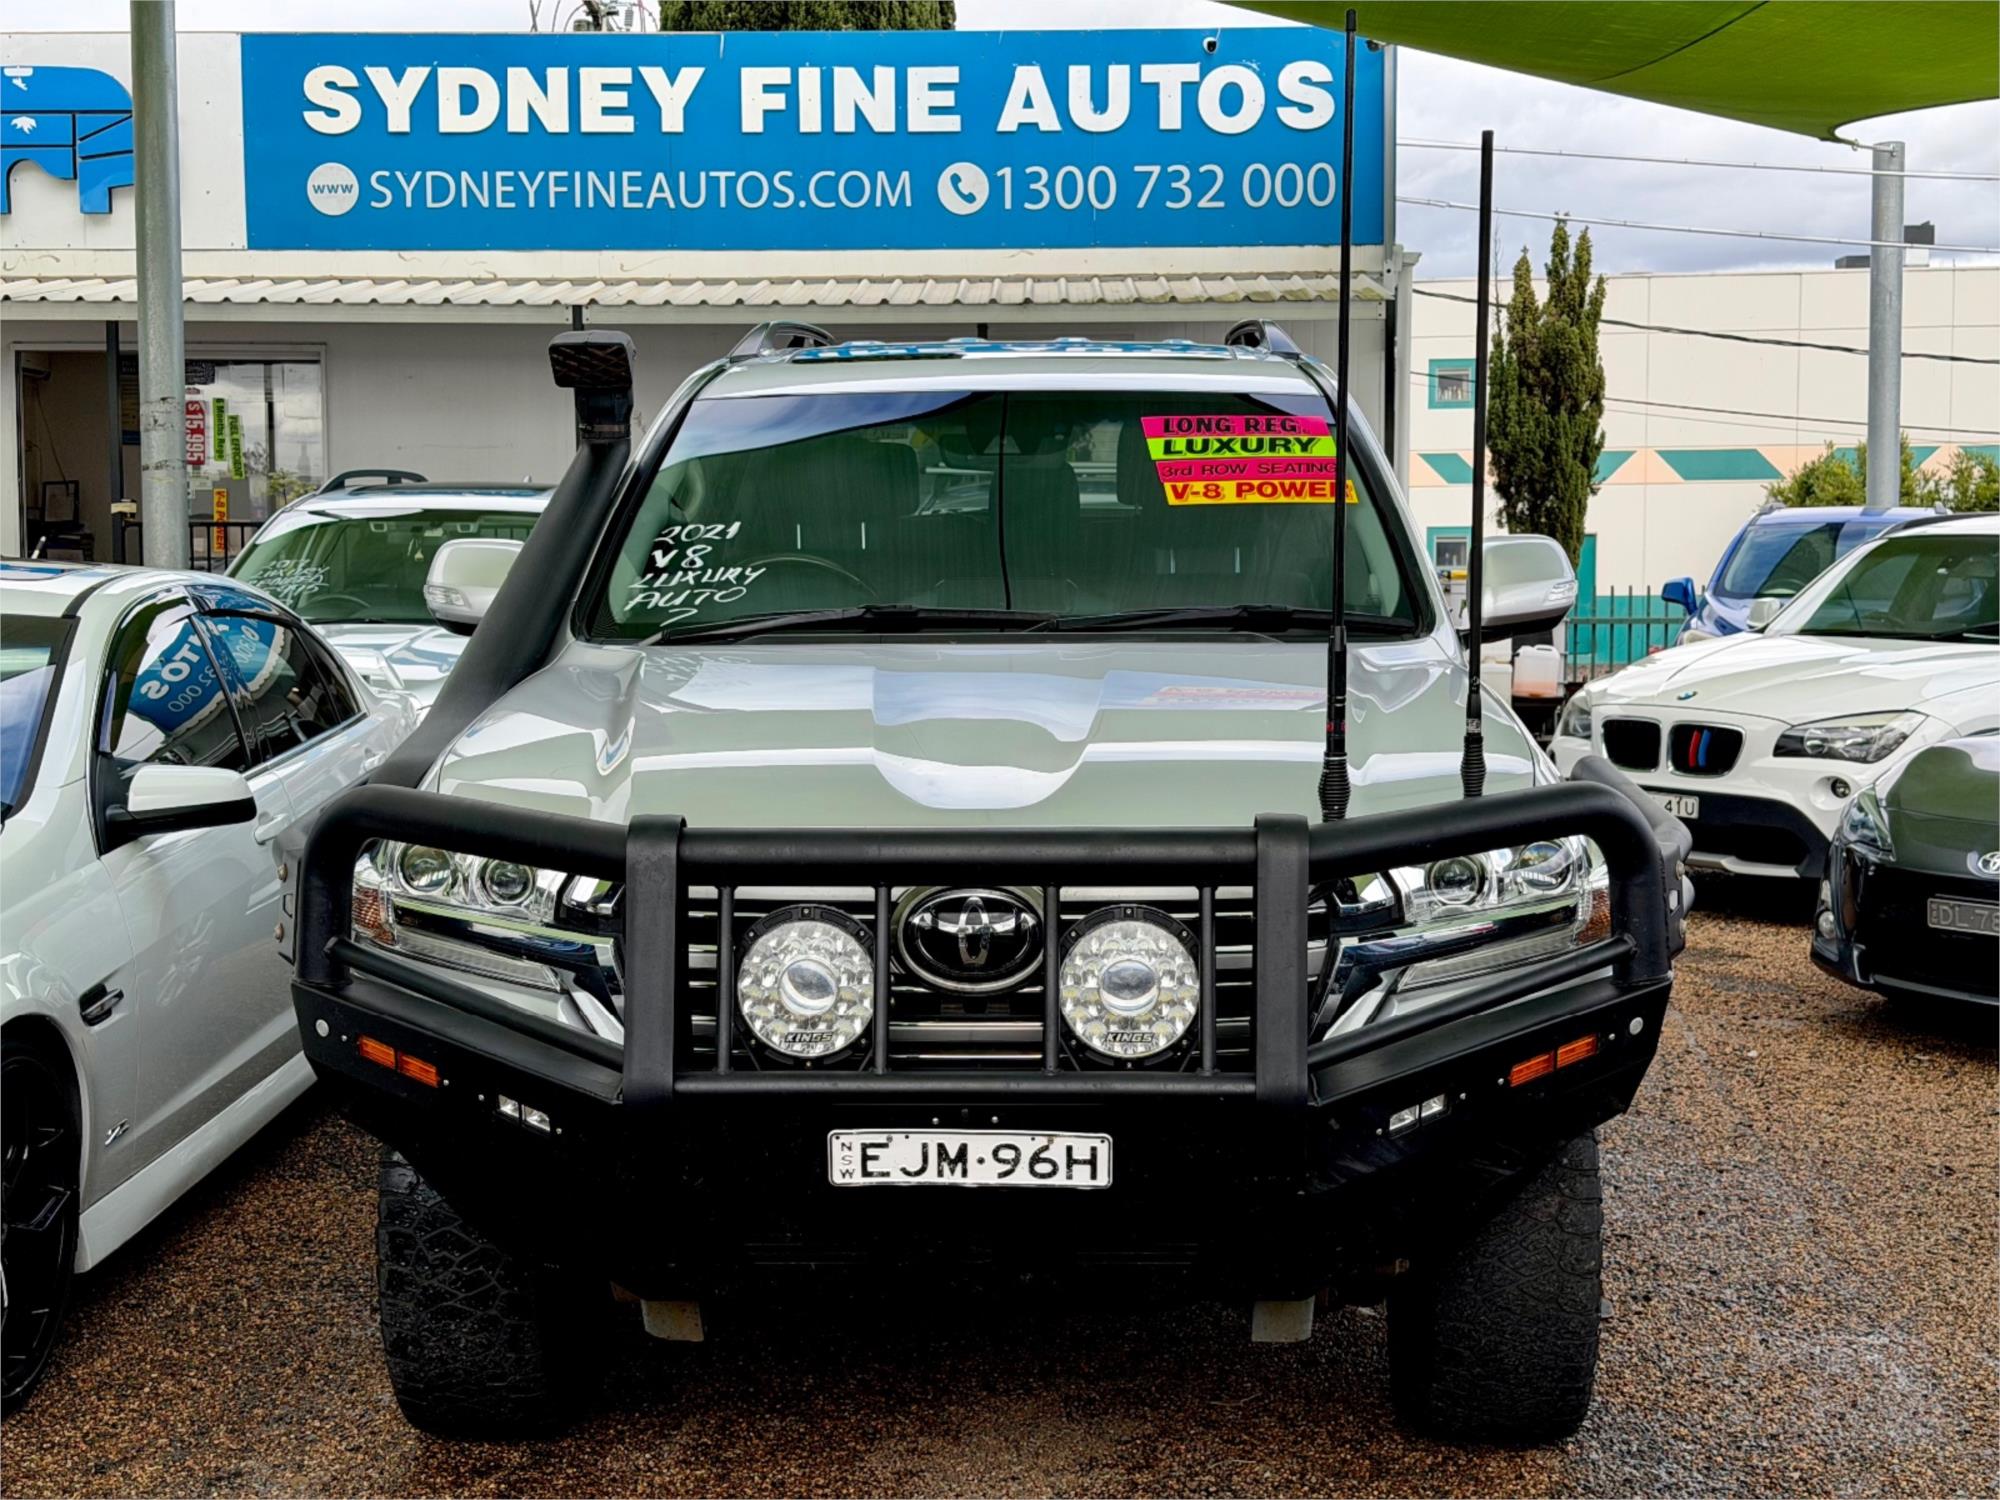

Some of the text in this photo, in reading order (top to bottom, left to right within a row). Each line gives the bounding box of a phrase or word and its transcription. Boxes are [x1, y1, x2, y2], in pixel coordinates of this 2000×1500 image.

[303, 60, 1336, 135] SYDNEY FINE AUTOS
[369, 169, 913, 209] SYDNEYFINEAUTOS.COM
[996, 161, 1337, 211] 1300 732 000
[1163, 417, 1231, 434] LONG
[229, 415, 244, 477] FUEL EFFICIENT
[1163, 437, 1320, 456] LUXURY
[1162, 461, 1337, 477] 3rd ROW SEATING
[1170, 482, 1222, 500] V-8
[654, 521, 742, 545] 2021
[628, 566, 767, 586] LUXURY
[623, 586, 747, 612] AUTO
[1105, 1032, 1154, 1043] KINGS
